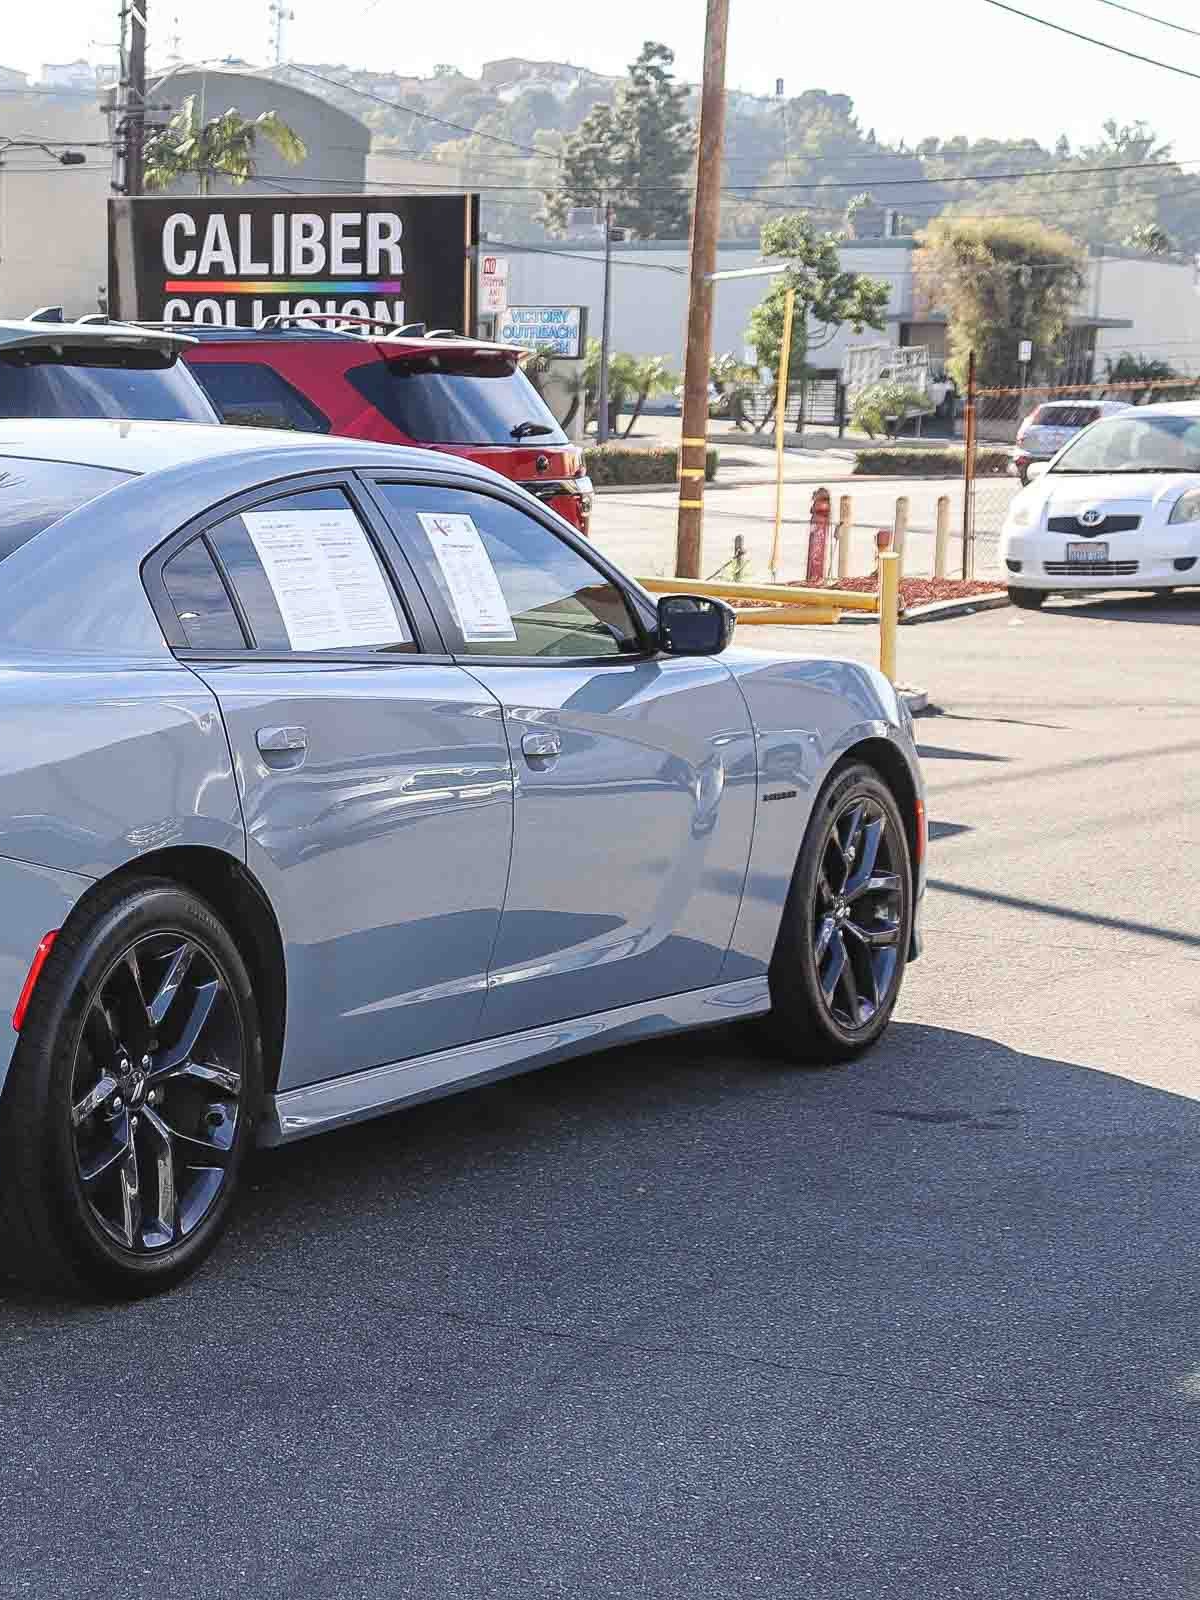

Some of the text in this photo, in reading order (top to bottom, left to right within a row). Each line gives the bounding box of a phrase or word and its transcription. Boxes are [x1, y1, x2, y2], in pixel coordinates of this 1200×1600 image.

[162, 212, 404, 276] CALIBER
[484, 259, 496, 274] NO
[512, 310, 569, 323] VICTORY
[503, 325, 576, 339] OUTREACH
